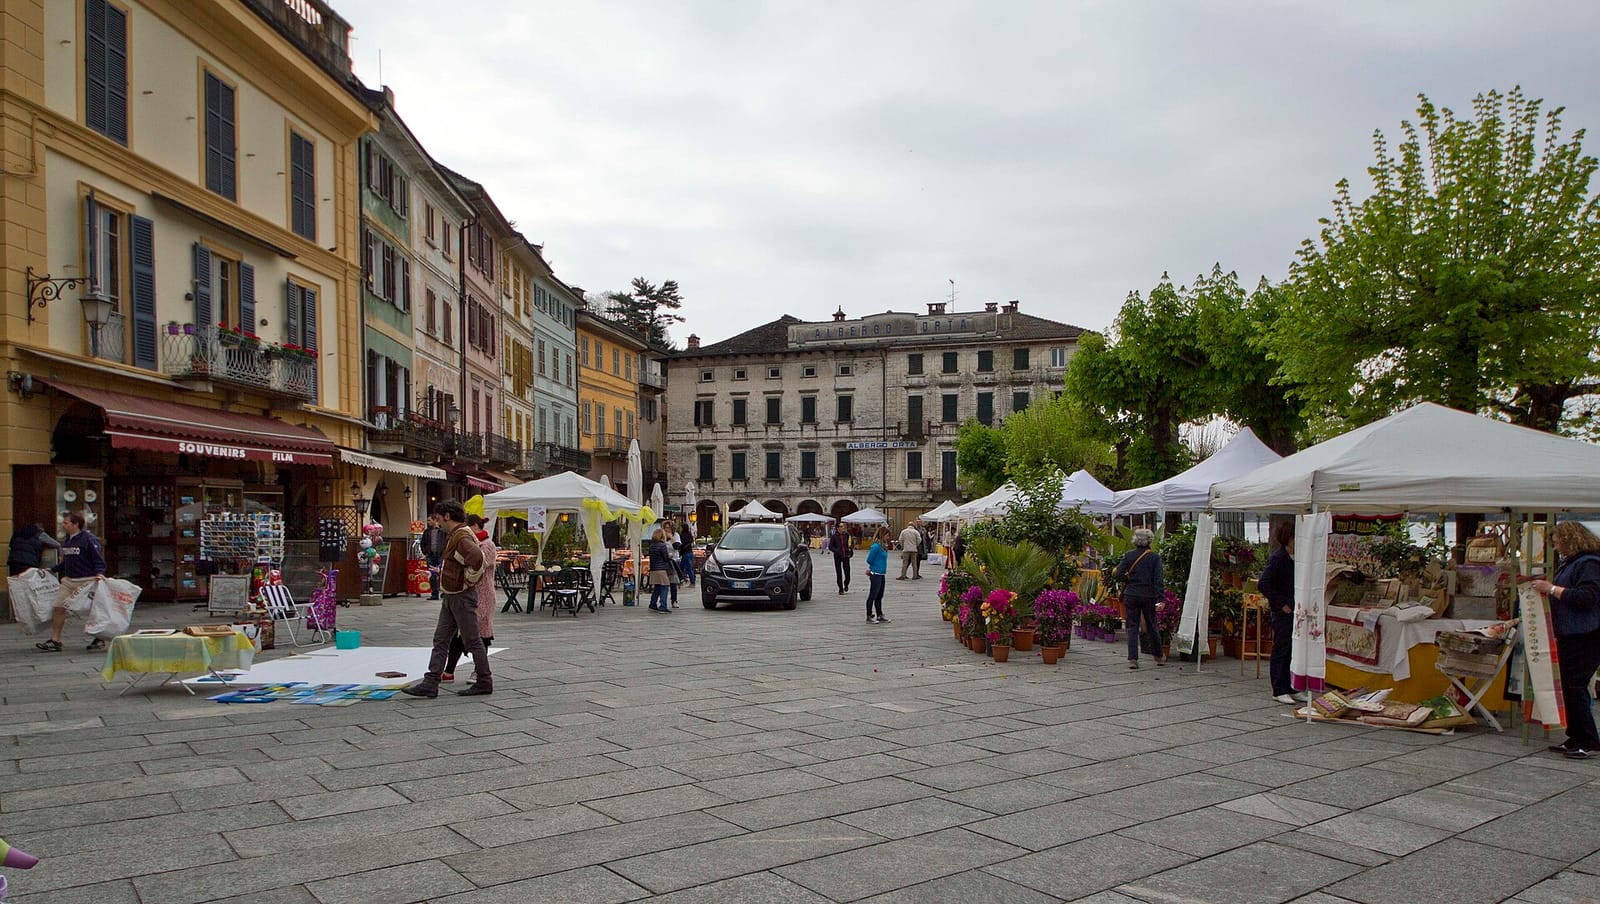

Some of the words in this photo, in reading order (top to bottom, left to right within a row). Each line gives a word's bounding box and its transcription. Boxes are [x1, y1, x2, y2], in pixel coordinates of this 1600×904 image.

[814, 323, 893, 338] ALBERGO
[922, 319, 968, 332] ORTA
[179, 442, 246, 458] SOUVENIRS
[272, 452, 294, 462] FILM
